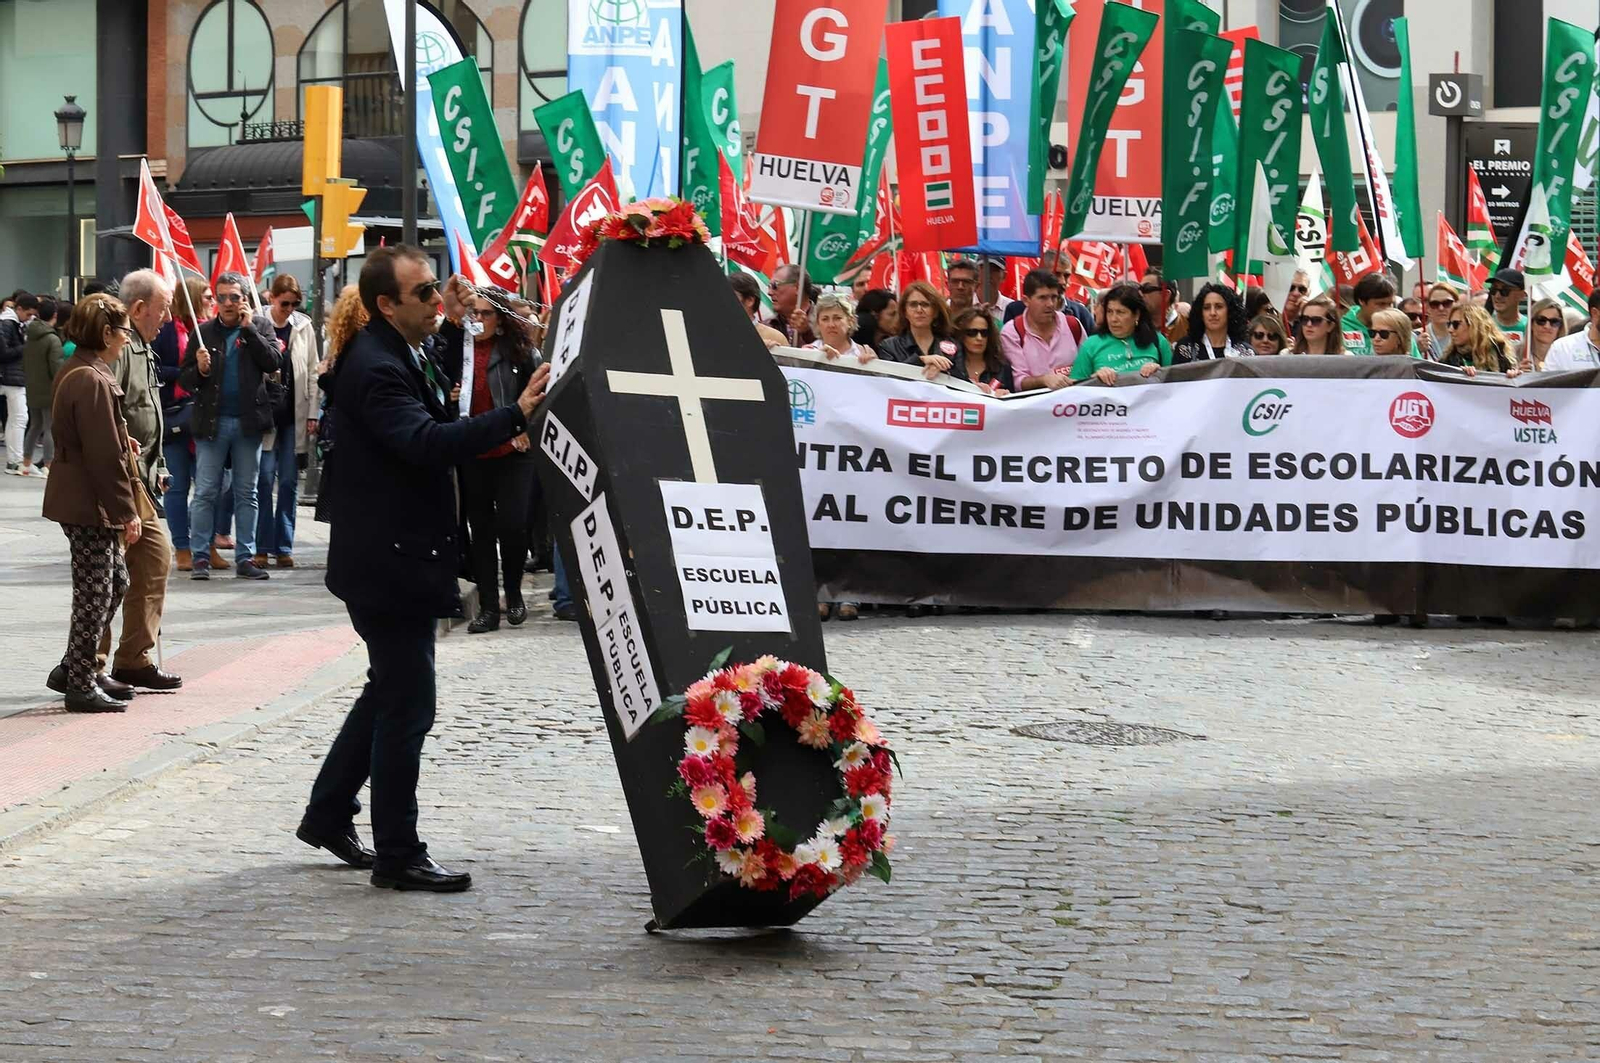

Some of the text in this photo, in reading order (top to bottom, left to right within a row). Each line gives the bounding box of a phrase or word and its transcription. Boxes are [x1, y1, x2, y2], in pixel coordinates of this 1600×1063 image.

[583, 26, 651, 44] ANPE
[759, 156, 851, 187] HUELVA
[1473, 160, 1531, 171] EL PREMIO
[1092, 198, 1162, 217] UELVA
[926, 215, 955, 226] HUELVA
[793, 408, 816, 423] PE
[893, 405, 962, 424] CCOO
[1252, 403, 1293, 420] CSIF
[1394, 399, 1430, 418] UGT
[1512, 405, 1551, 418] HUELVA
[1514, 428, 1558, 444] USTEA
[544, 419, 590, 493] R.I.P.
[908, 453, 957, 482] EL
[972, 455, 1165, 484] DECRETO
[1181, 452, 1232, 480] DE
[1248, 452, 1600, 489] ESCOLARIZACIÓN
[671, 506, 768, 532] D.E.P.
[812, 494, 1586, 540] AL CIERRE DE UNIDADES PÚBLICAS
[583, 511, 614, 617] D.E.P.
[682, 567, 778, 585] ESCUELA
[692, 596, 782, 616] PÚBLICA
[619, 611, 653, 712] ESCUELA
[605, 629, 638, 725] PÚBLICA
